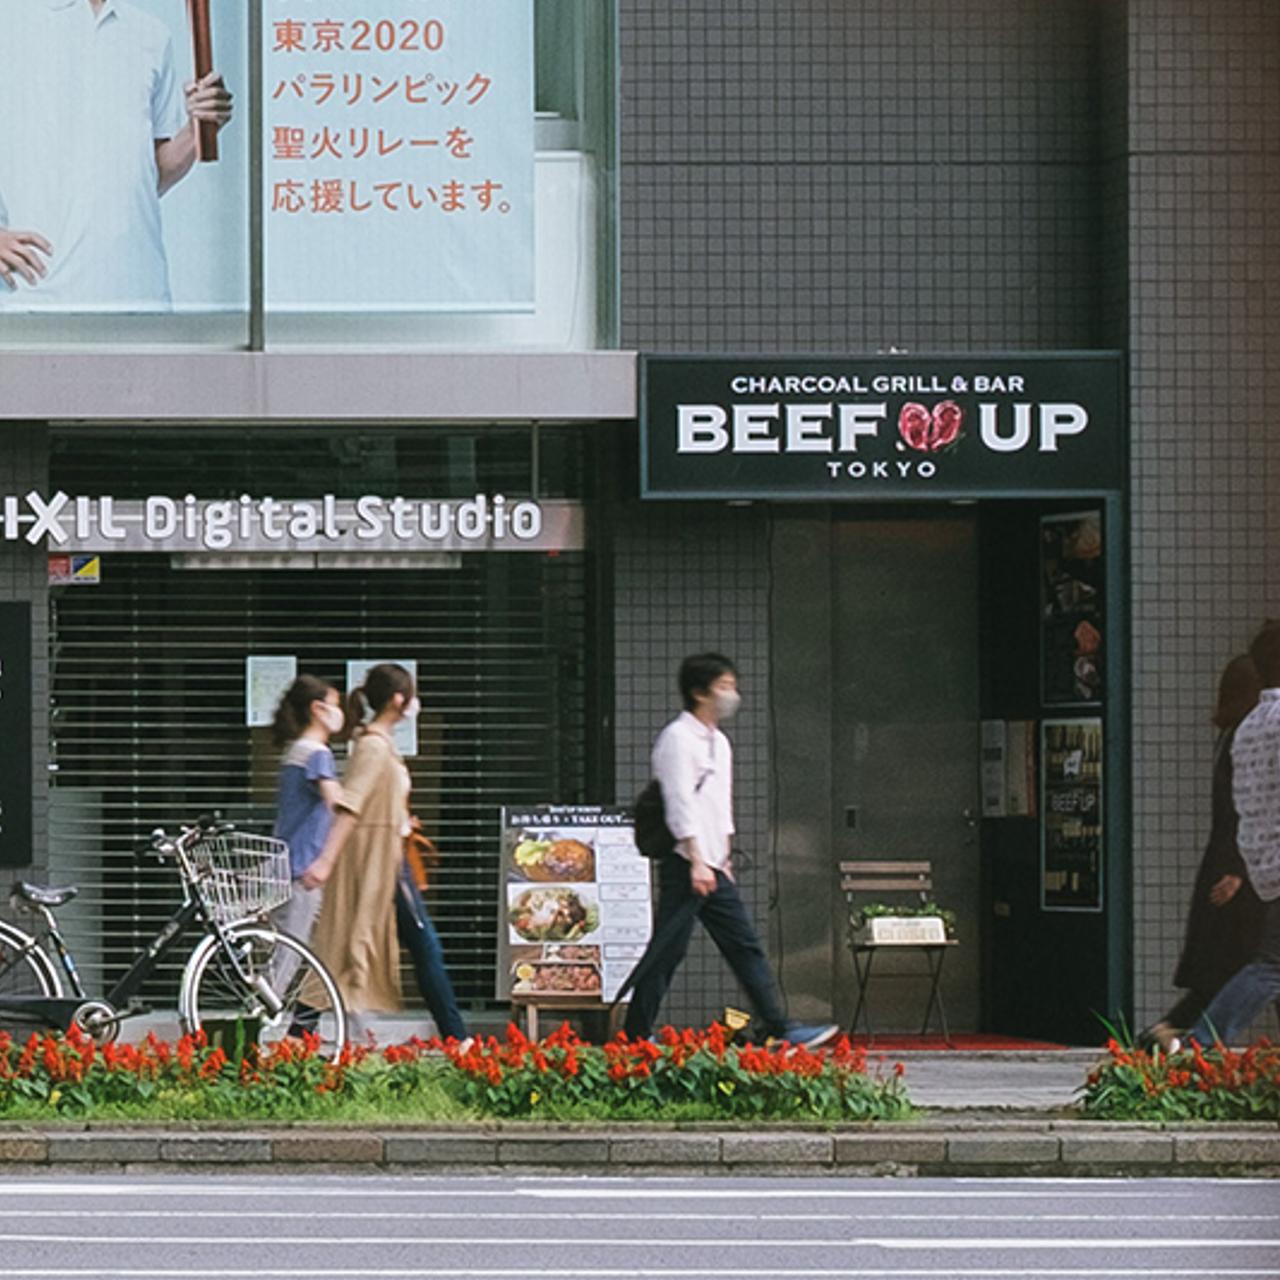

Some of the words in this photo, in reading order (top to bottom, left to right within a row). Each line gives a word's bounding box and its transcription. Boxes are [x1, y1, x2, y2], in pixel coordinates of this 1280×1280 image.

[272, 19, 445, 52] 東京2020
[272, 73, 492, 105] パラリンピック
[271, 126, 474, 159] 聖火リレーを
[271, 179, 512, 214] 応援しています。
[731, 375, 868, 394] CHARCOAL
[873, 375, 951, 394] GRILL
[952, 375, 969, 394] &
[974, 376, 1025, 393] BAR
[676, 402, 887, 453] BEEF
[979, 402, 1089, 453] UP
[827, 461, 936, 478] TOKYO
[145, 494, 341, 549] Digital
[356, 494, 542, 540] Studio
